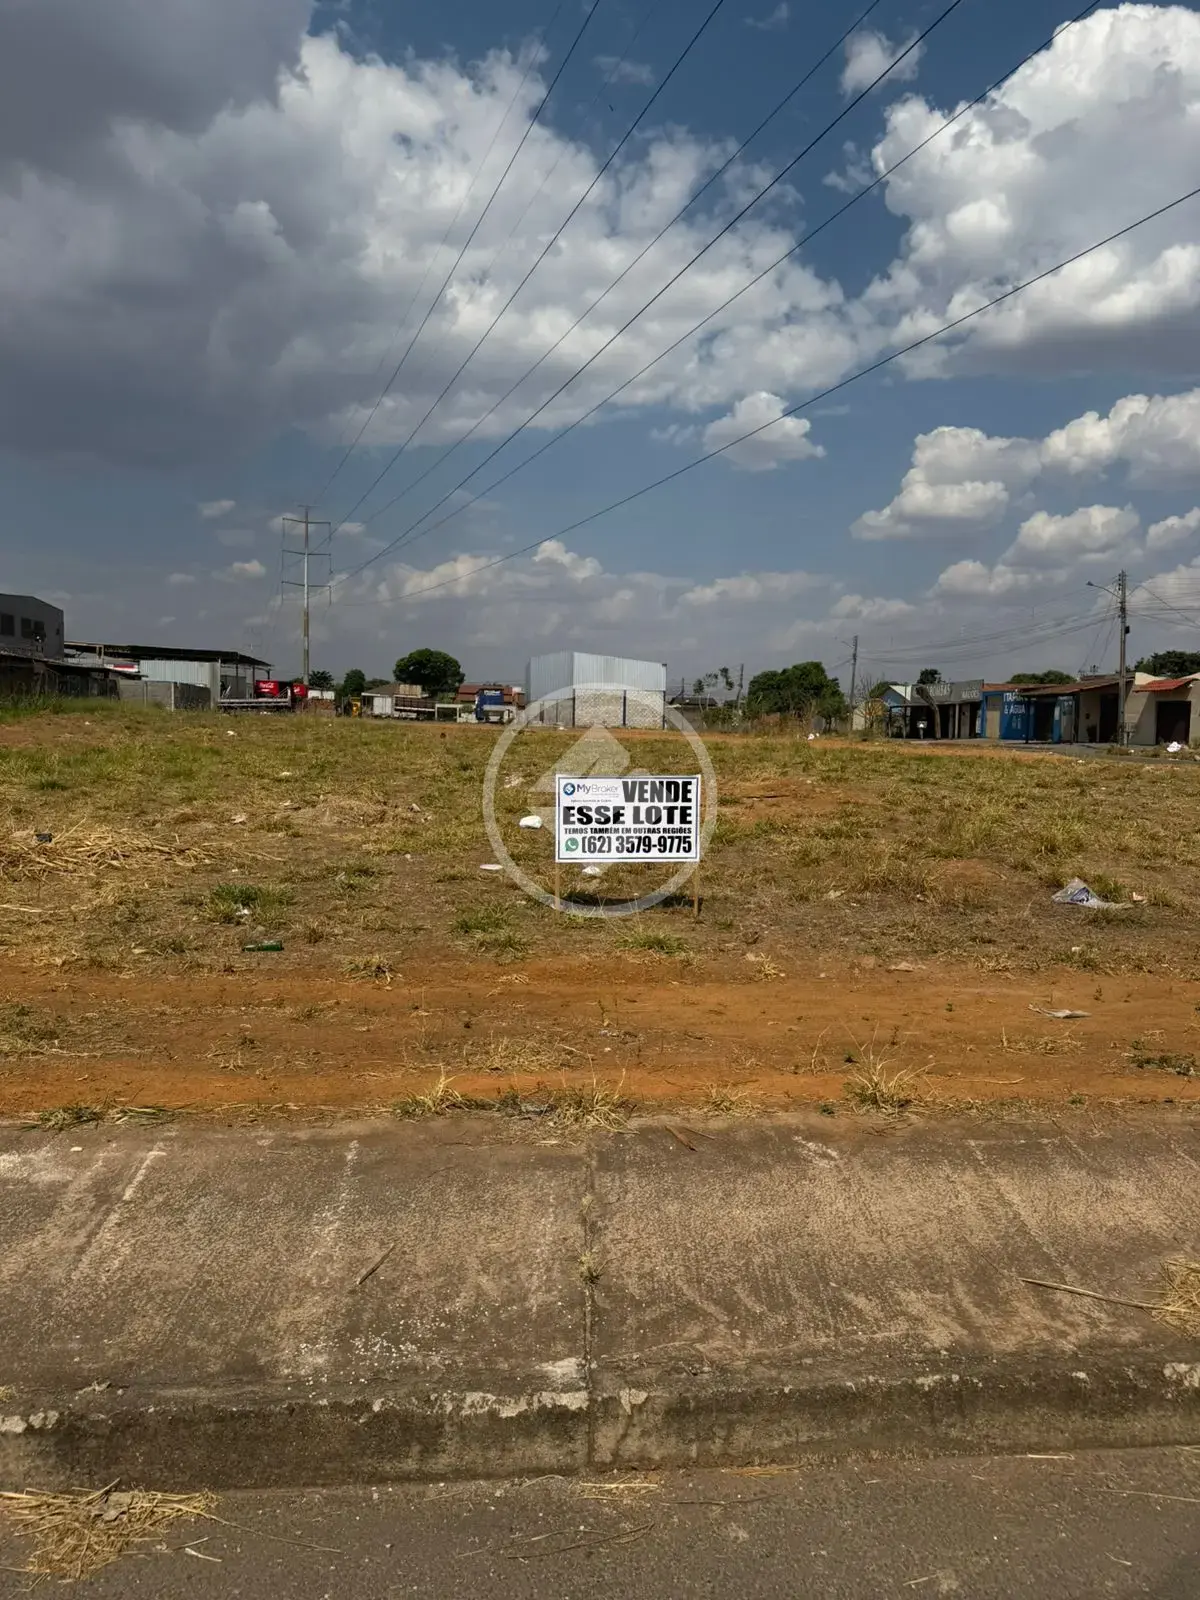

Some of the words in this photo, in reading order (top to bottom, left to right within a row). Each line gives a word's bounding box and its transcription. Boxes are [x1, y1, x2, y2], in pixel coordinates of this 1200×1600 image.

[622, 780, 692, 803] VENDE
[562, 805, 625, 825] ESSE
[633, 805, 692, 825] LOTE
[590, 826, 620, 834] TAMBÉM
[662, 826, 692, 834] REGIÕES
[581, 835, 612, 854] (62)
[615, 835, 692, 854] 3579-9775
